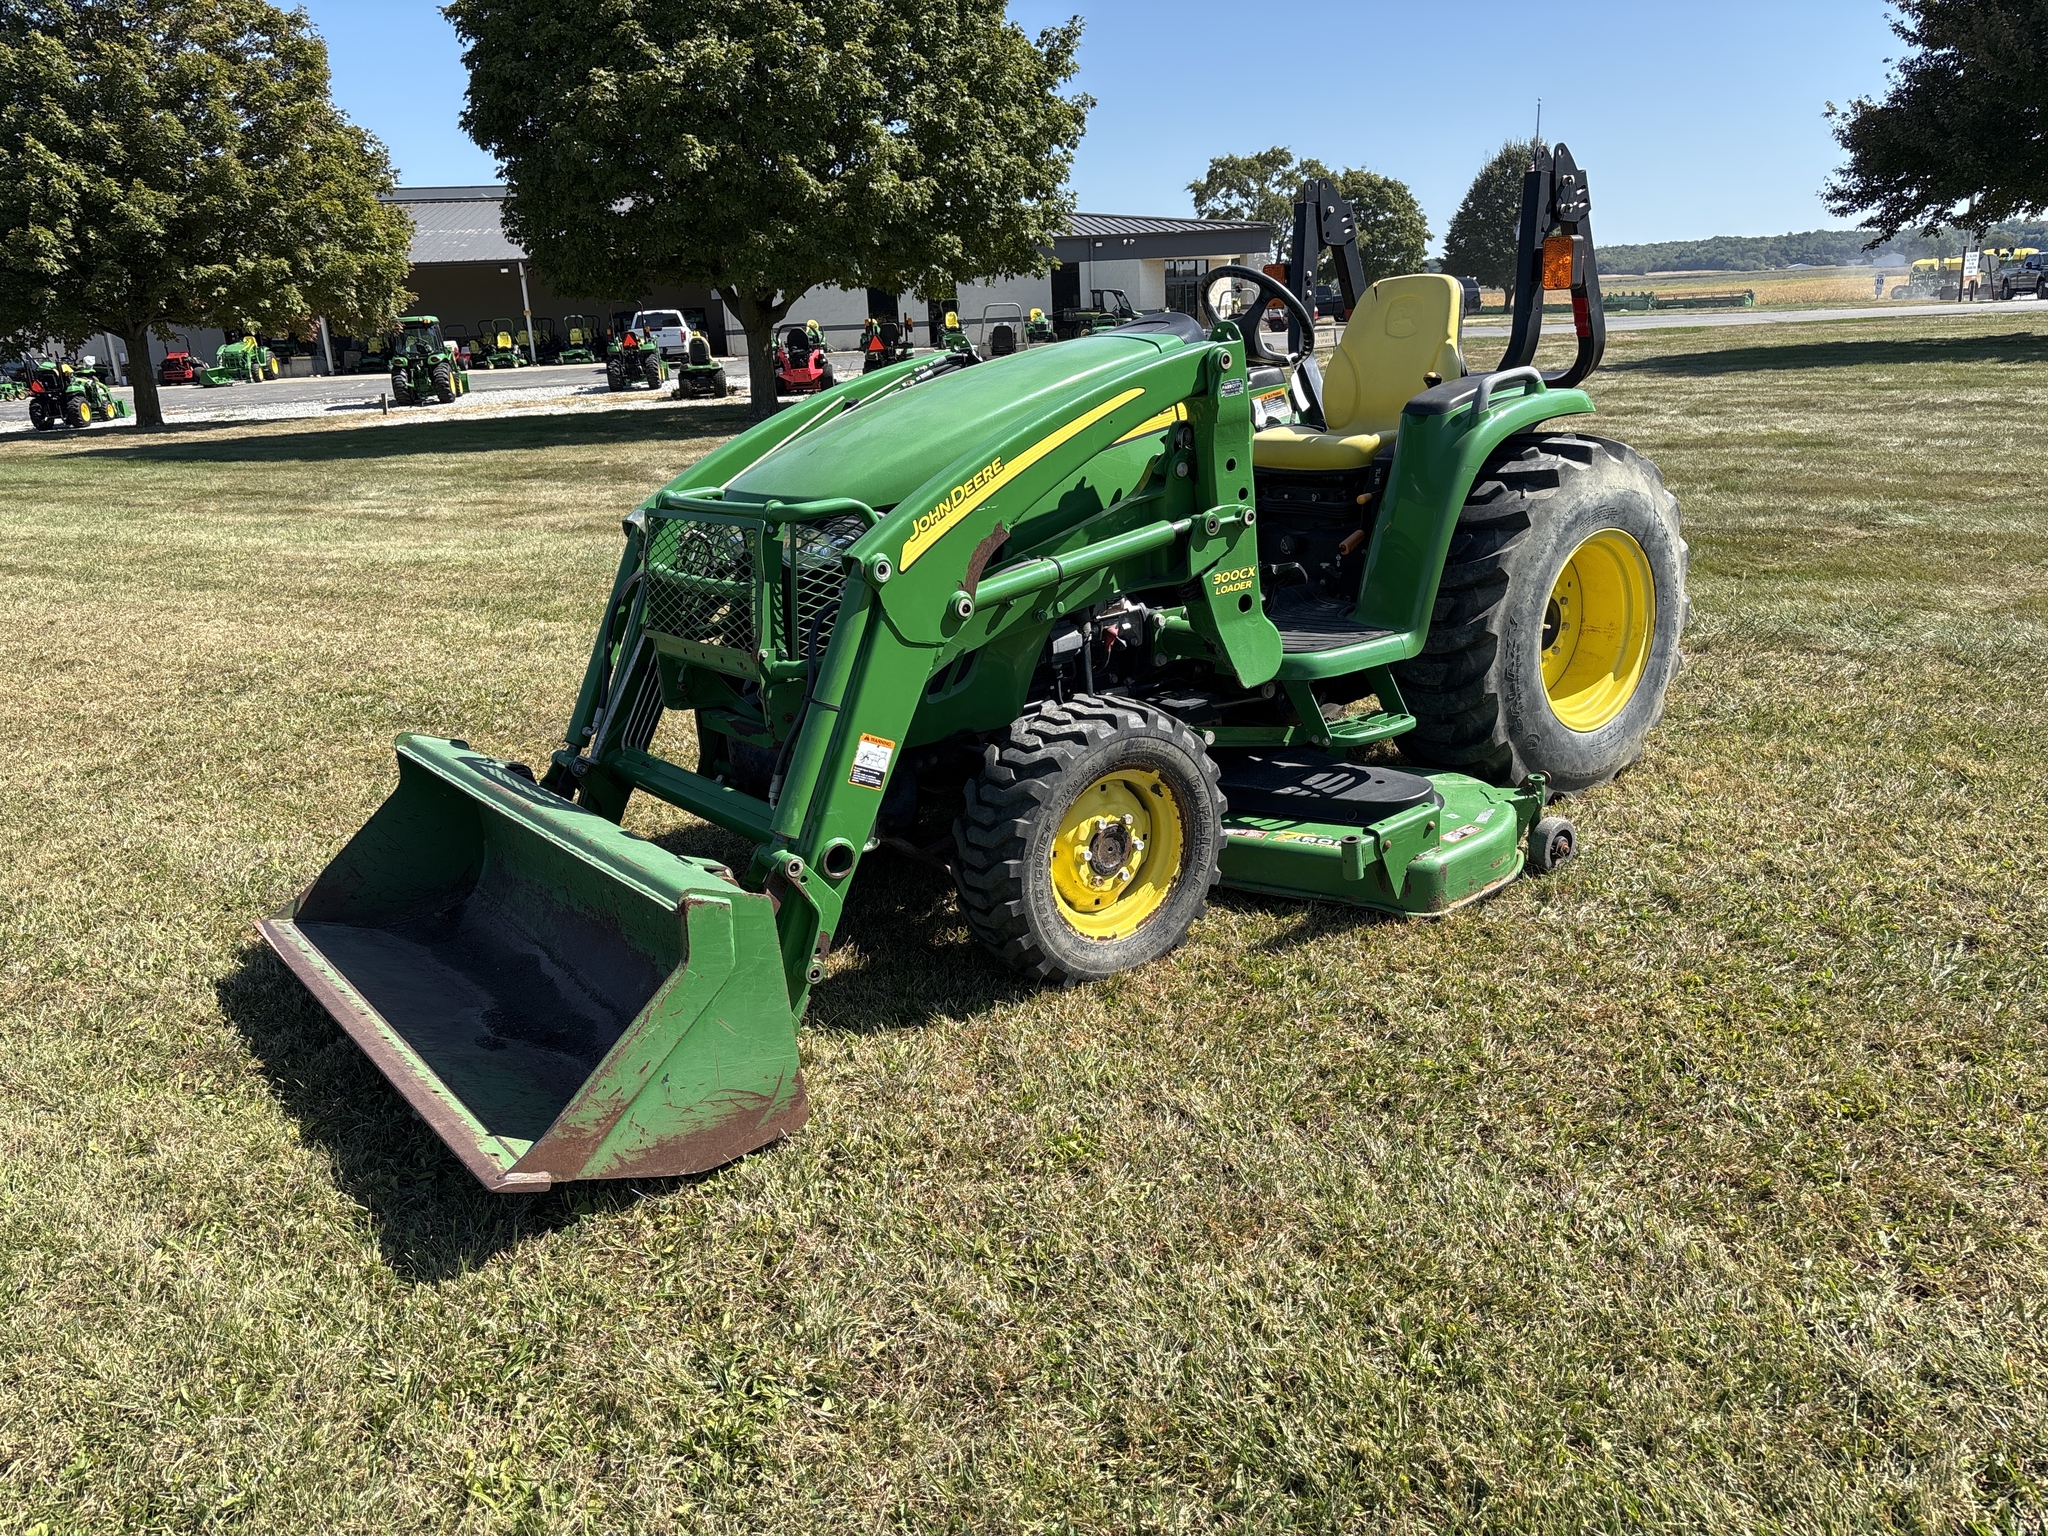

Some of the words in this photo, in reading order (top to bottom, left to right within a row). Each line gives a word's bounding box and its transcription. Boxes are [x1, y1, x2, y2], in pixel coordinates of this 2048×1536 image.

[909, 498, 953, 542] JOHN
[950, 456, 1004, 508] DEERE
[1212, 565, 1256, 585] 300CX
[1215, 580, 1253, 595] LOADER
[1034, 818, 1055, 883] CHIEF
[1187, 774, 1212, 894] CARLISLE
